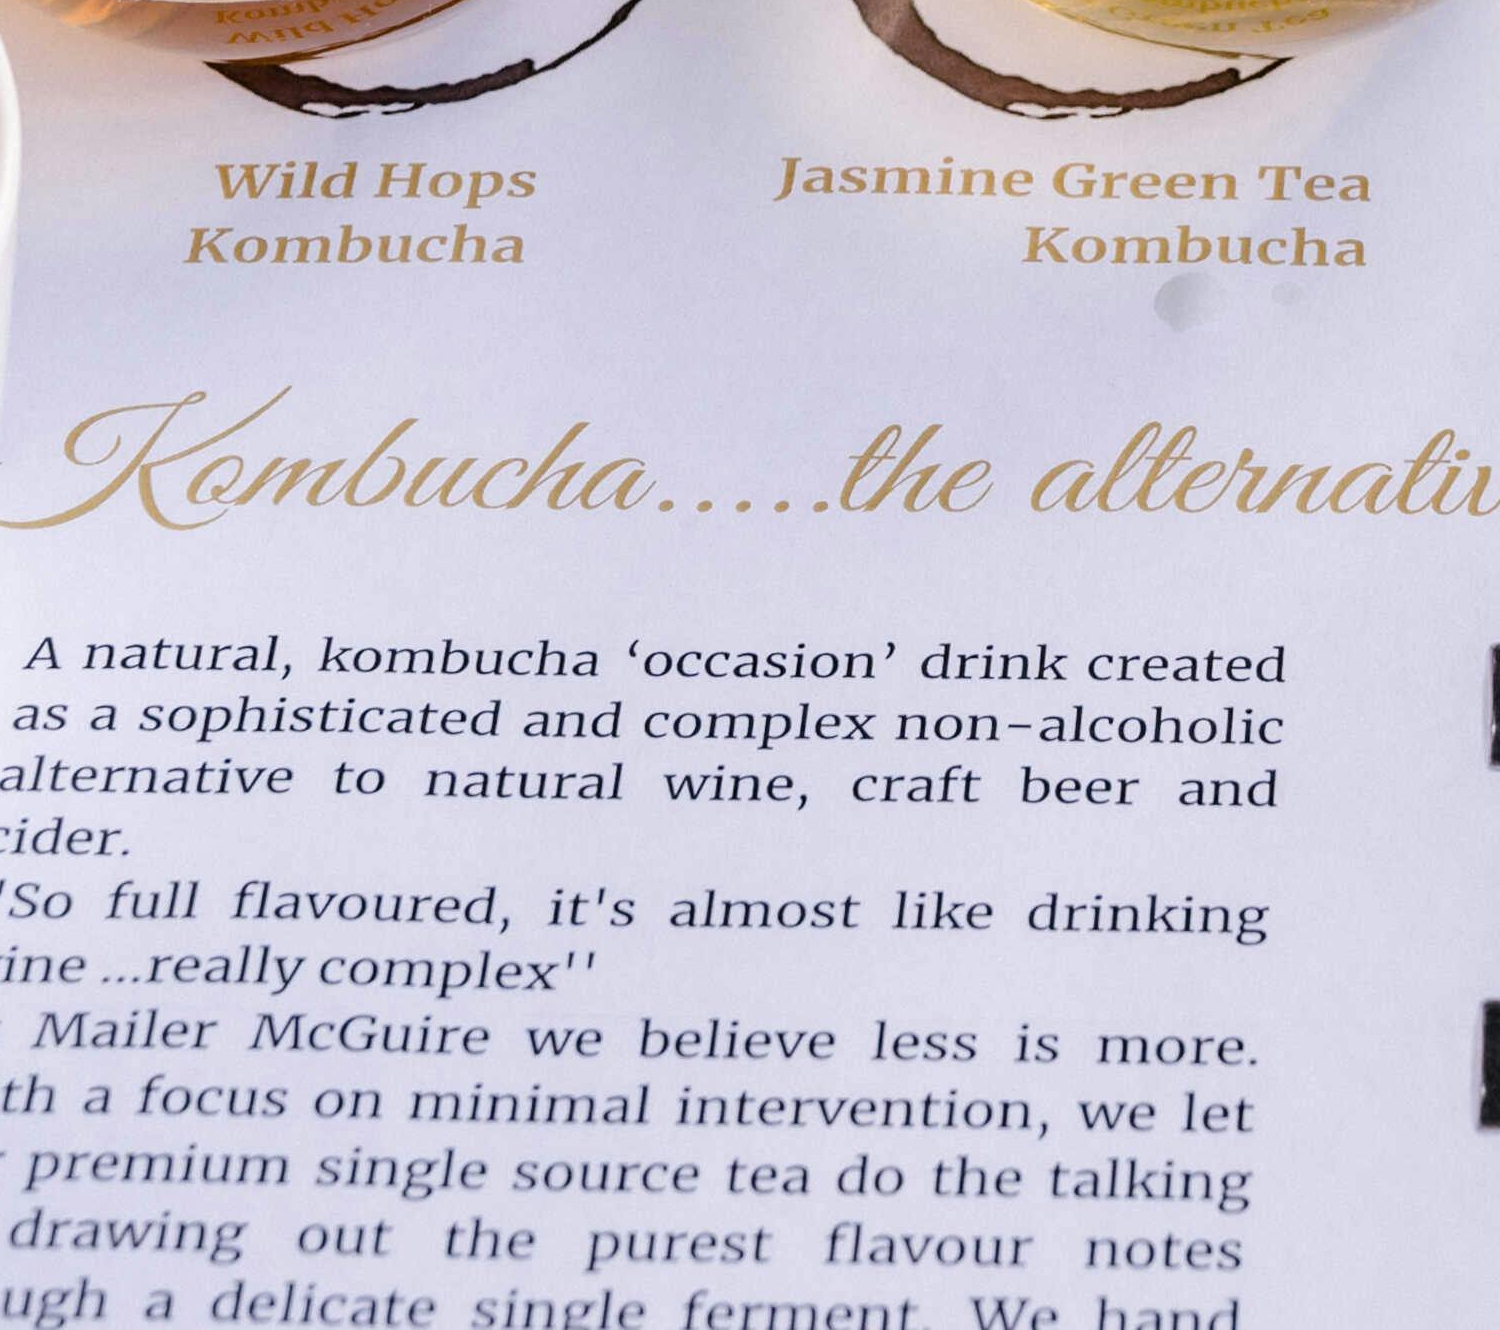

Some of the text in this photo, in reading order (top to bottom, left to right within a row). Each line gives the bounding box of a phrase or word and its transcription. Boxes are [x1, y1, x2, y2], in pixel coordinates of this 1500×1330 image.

[215, 159, 538, 211] Wild Hops
[772, 155, 1371, 204] Jasmine Green Tea
[183, 222, 525, 265] Kombucha
[1022, 223, 1367, 268] Kombucha
[22, 635, 62, 671] A
[81, 633, 293, 682] natural,
[317, 634, 599, 678] kombucha
[919, 641, 1069, 682] drink
[1086, 644, 1286, 685] created
[11, 703, 69, 732] as
[88, 703, 118, 732] a
[137, 694, 503, 744] sophisticated
[521, 699, 624, 740] and
[642, 701, 877, 752] complex
[333, 760, 387, 796] to
[424, 761, 625, 801] natural
[662, 763, 809, 812] wine,
[850, 763, 983, 805] craft
[1020, 764, 1141, 807] beer
[1177, 767, 1278, 809] and
[104, 878, 201, 921] full
[231, 878, 511, 936] flavoured,
[668, 887, 862, 930] almost
[891, 889, 995, 932] like
[1026, 891, 1271, 948] drinking
[30, 1007, 219, 1051] Mailer
[248, 1012, 492, 1057] McGuire
[525, 1027, 604, 1059] we
[638, 1016, 837, 1061] believe
[871, 1018, 978, 1063] less
[1015, 1022, 1060, 1064] is
[1096, 1034, 1258, 1067] more.
[81, 1084, 112, 1116] a
[137, 1072, 289, 1118] focus
[312, 1088, 382, 1120] on
[408, 1081, 651, 1126] minimal
[676, 1085, 1050, 1141] intervention,
[1077, 1100, 1157, 1133] we
[1182, 1090, 1255, 1134] let
[23, 1142, 290, 1194] premium
[314, 1145, 489, 1201] single
[511, 1161, 701, 1194] source
[727, 1157, 810, 1196] tea
[835, 1152, 906, 1197] do
[932, 1154, 1024, 1198] the
[1050, 1156, 1253, 1215] talking
[7, 1206, 248, 1265] drawing
[296, 1219, 392, 1258] out
[444, 1215, 537, 1261] the
[584, 1227, 772, 1274] purest
[824, 1220, 1035, 1268] flavour
[1085, 1232, 1243, 1271] notes
